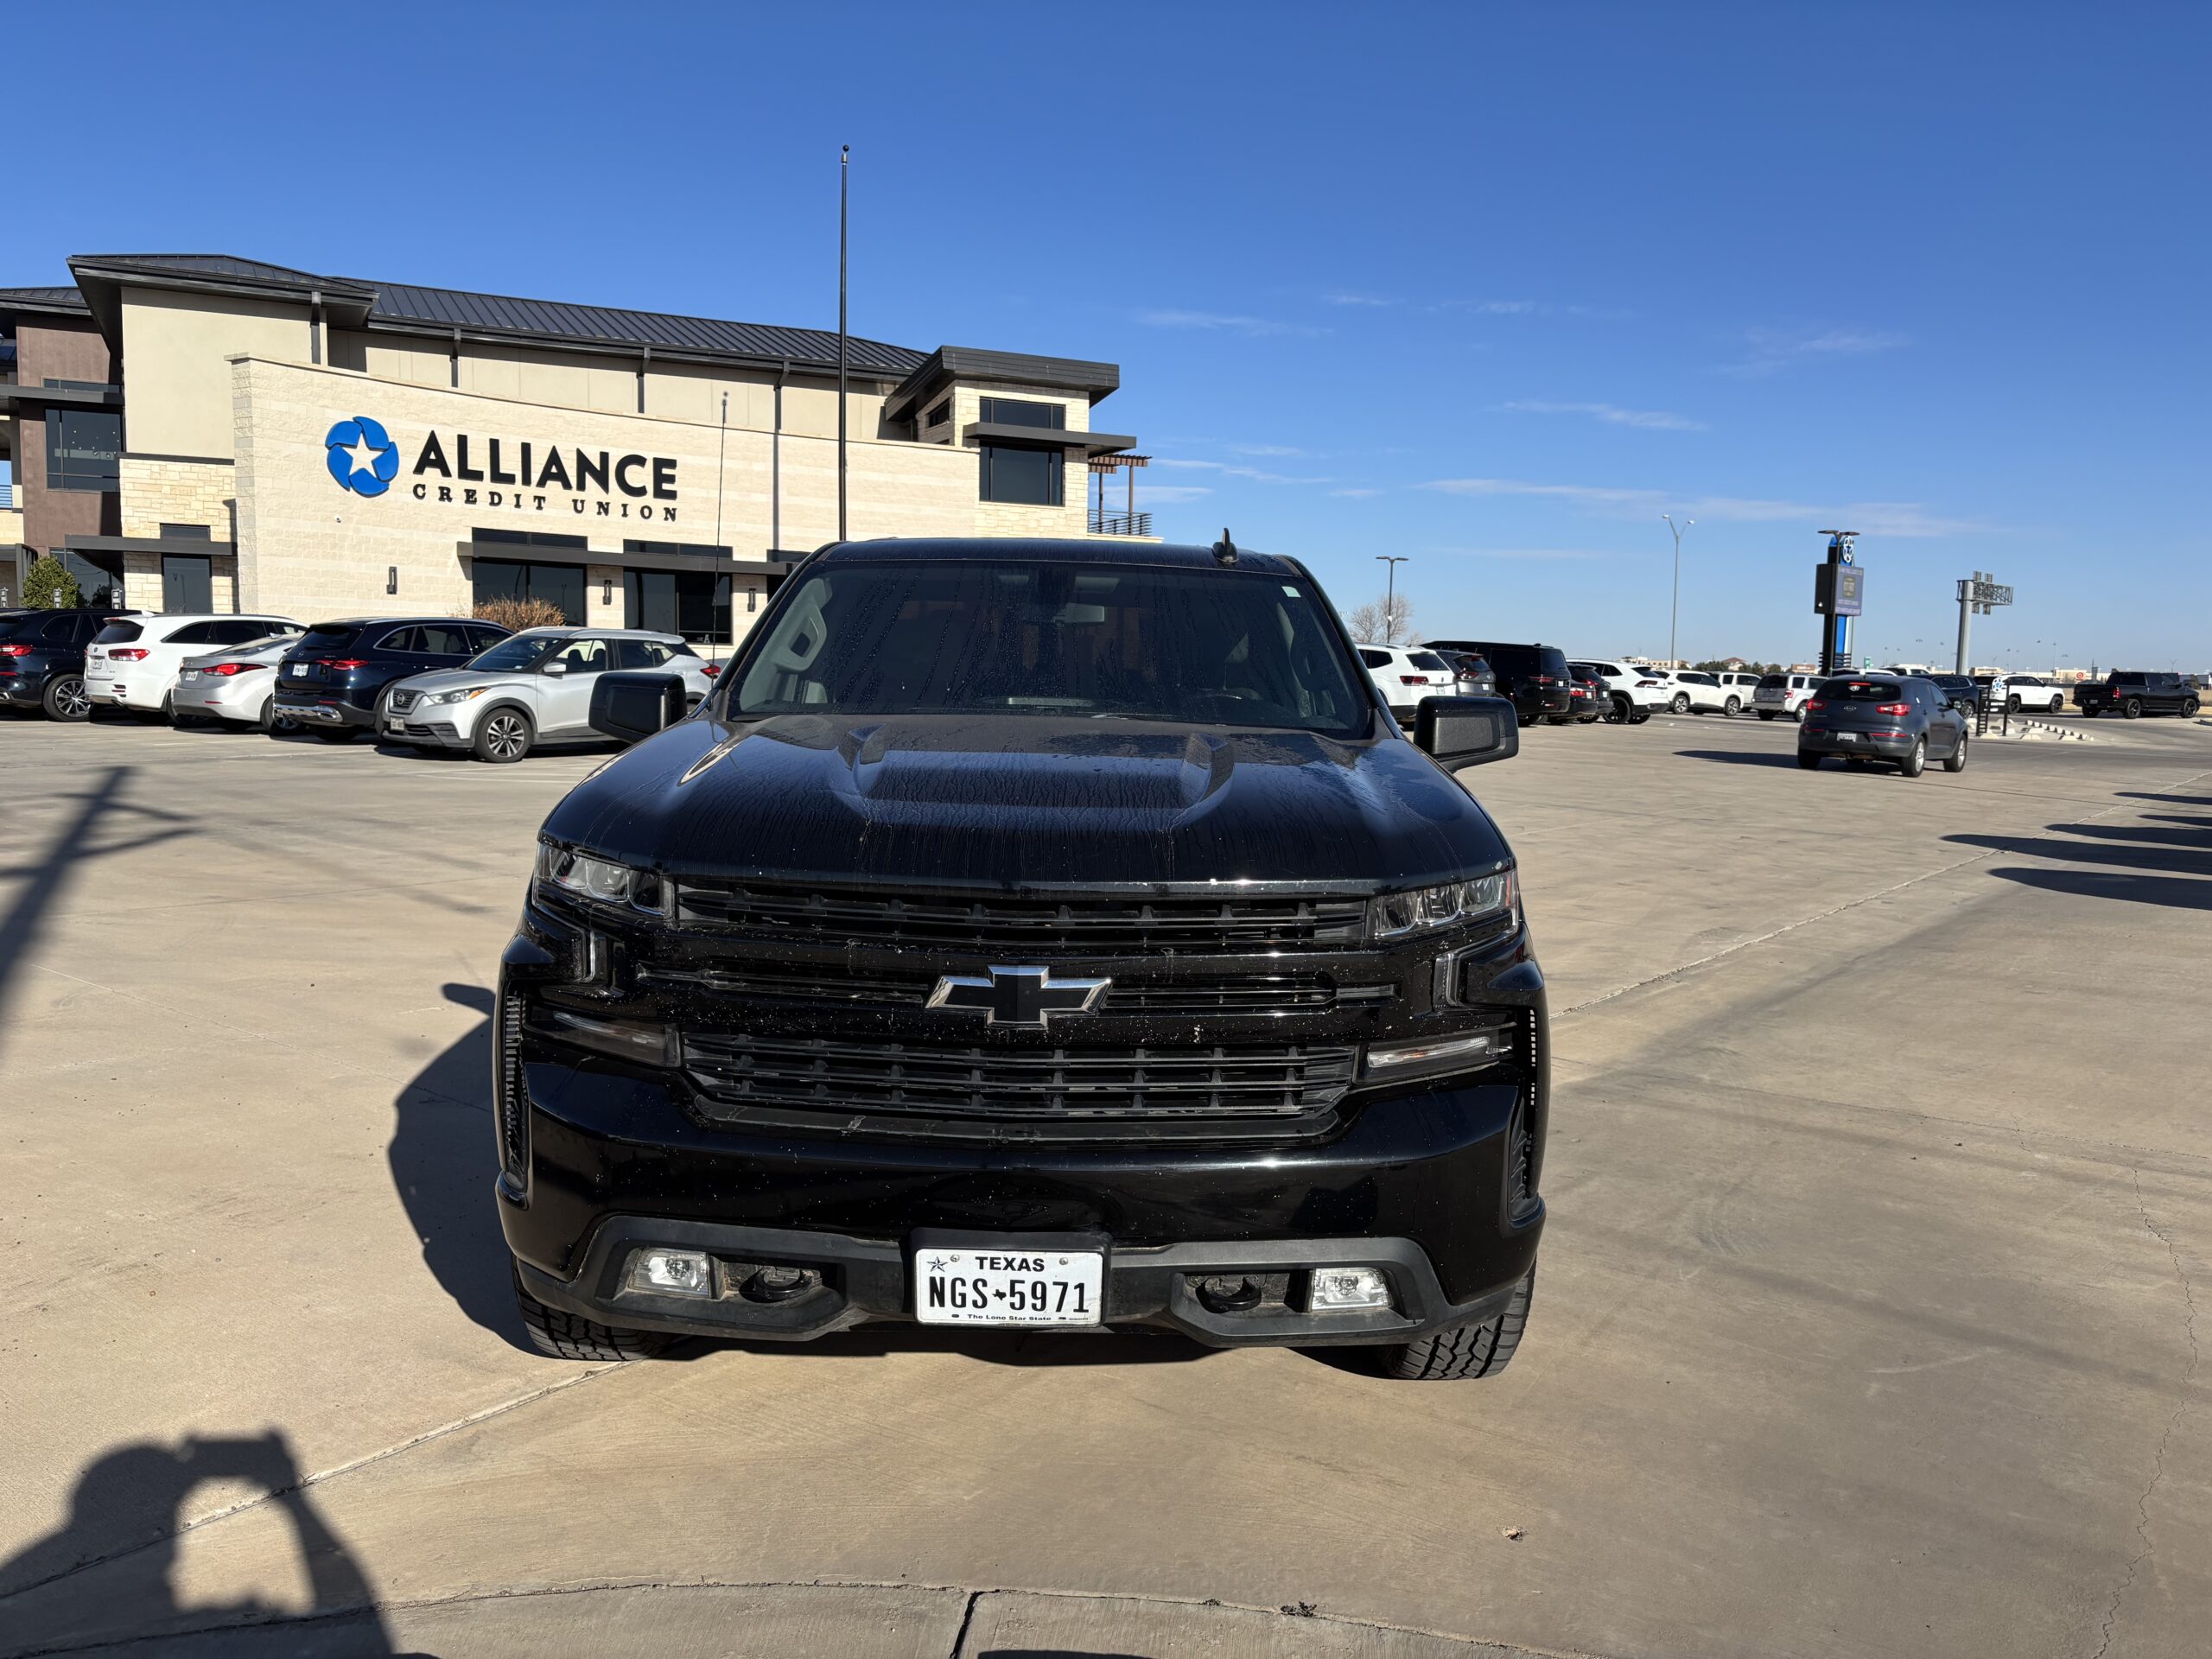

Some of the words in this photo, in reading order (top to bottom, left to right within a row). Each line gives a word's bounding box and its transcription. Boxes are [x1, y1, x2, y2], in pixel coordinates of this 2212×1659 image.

[413, 429, 677, 500] ALLIANCE
[413, 484, 546, 511] CREDIT
[572, 499, 677, 522] UNION
[975, 1256, 1045, 1272] TEXAS
